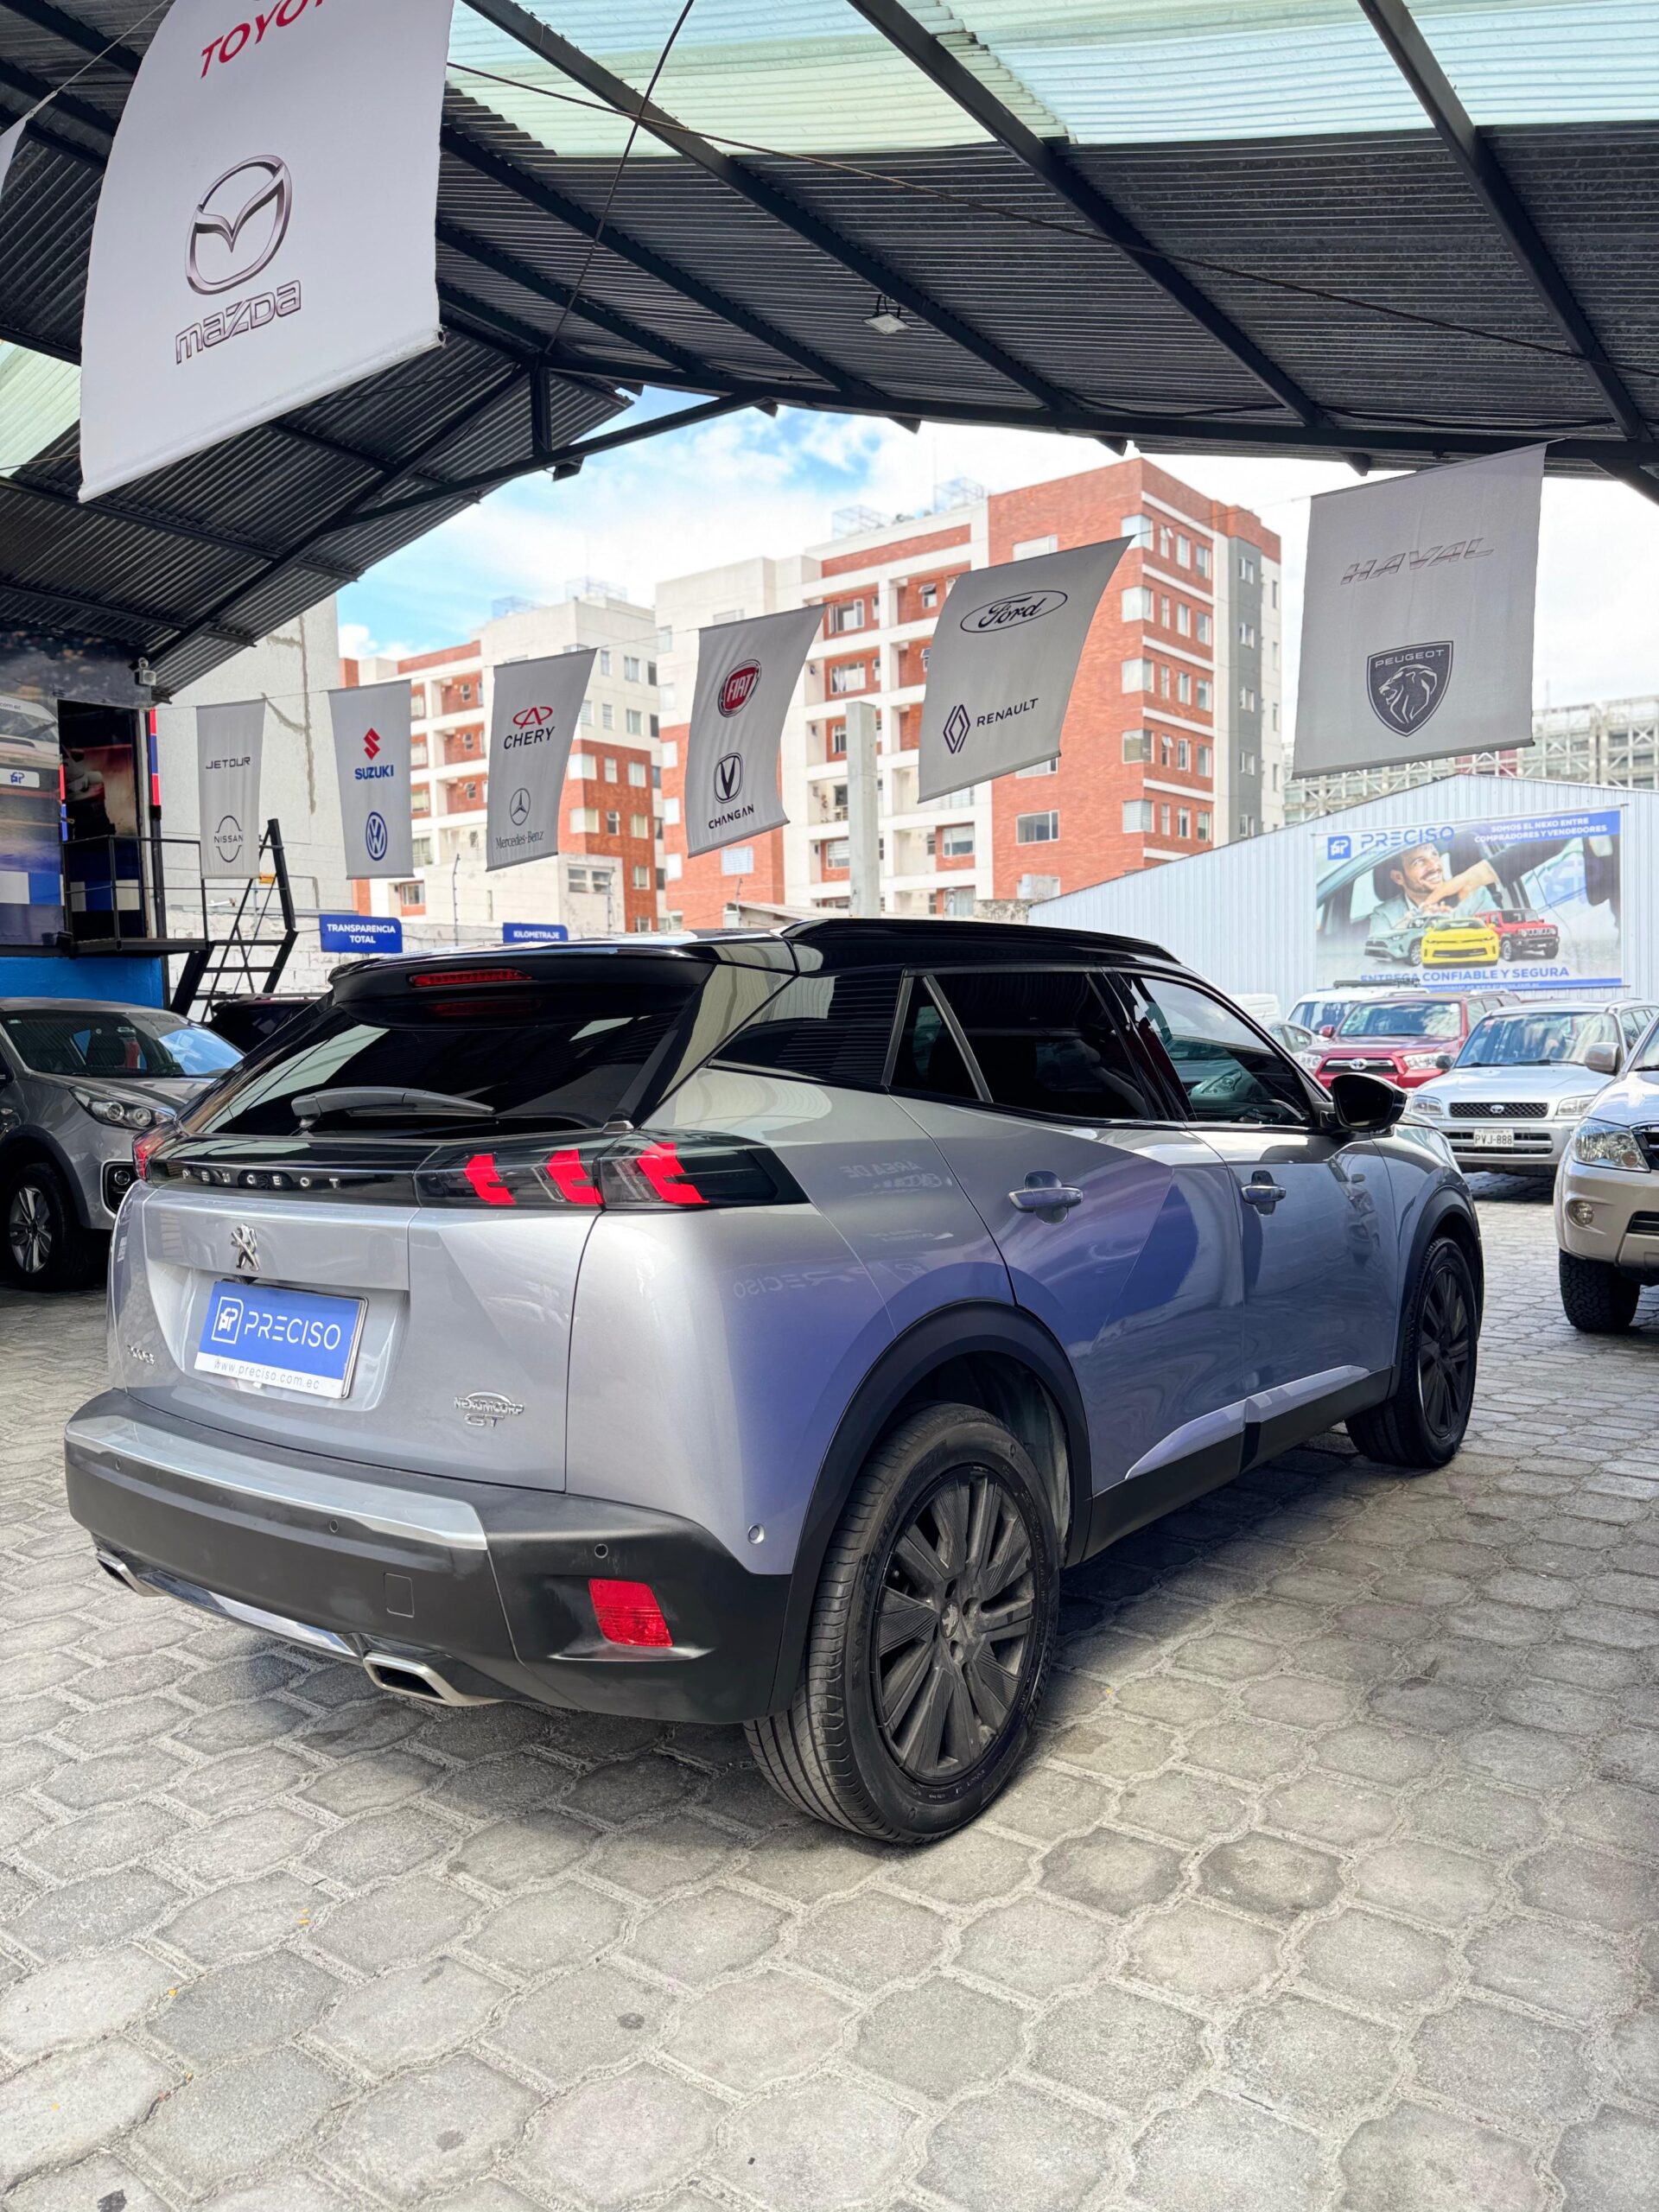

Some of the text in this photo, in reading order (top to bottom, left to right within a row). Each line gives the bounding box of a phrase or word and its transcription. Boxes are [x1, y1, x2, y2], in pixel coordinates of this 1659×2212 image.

[200, 0, 323, 79] TOYO
[1340, 537, 1495, 585] HAVAL
[978, 595, 1047, 629] Ford
[1375, 649, 1445, 668] PEUGEOT
[727, 672, 754, 702] FIAT
[976, 697, 1039, 728] RENAULT
[503, 726, 556, 750] CHERY
[206, 756, 251, 769] JETOUR
[354, 764, 395, 780] SUZUKI
[708, 804, 755, 830] CHANGAN
[1491, 823, 1522, 833] SOMOS
[1560, 817, 1589, 826] ENTRE
[213, 835, 244, 843] NISSAN
[495, 830, 544, 850] Mercedes-Benz
[1361, 826, 1454, 849] PRECISO
[1474, 830, 1540, 842] COMPRADORES
[1547, 824, 1607, 836] VENDEDORES
[327, 924, 397, 934] TRANSPARENCIA
[513, 930, 560, 939] KILOMETRAJE
[349, 935, 377, 944] TOTAL
[1422, 969, 1498, 982] CONFIABLE
[1501, 969, 1510, 978] Y
[1512, 966, 1570, 978] SEGURA
[1474, 1134, 1512, 1145] PVJ-888
[181, 1169, 339, 1190] PEUGEOT
[244, 1311, 341, 1350] PRECISO
[213, 1357, 320, 1390] www.preciso.com.ec
[464, 1413, 505, 1427] GT
